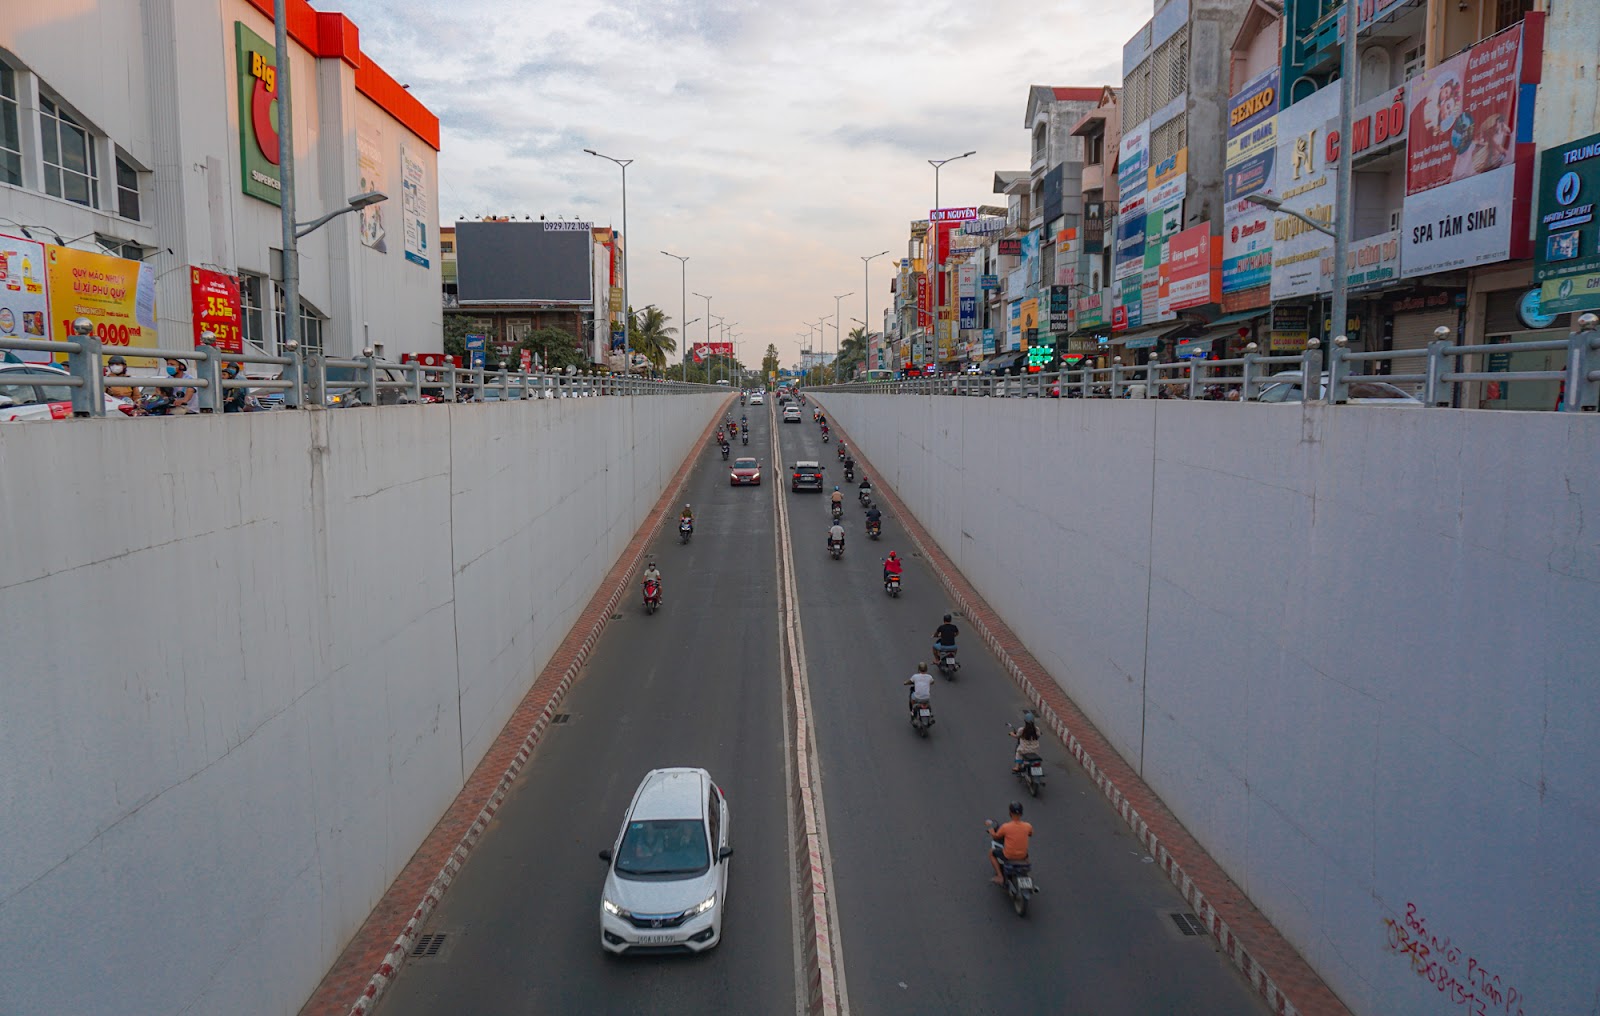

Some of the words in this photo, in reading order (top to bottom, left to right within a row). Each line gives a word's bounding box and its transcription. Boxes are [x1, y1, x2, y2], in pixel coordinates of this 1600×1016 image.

[251, 51, 275, 93] Big
[1229, 86, 1275, 128] SENKO
[1325, 115, 1371, 163] CM
[1563, 142, 1600, 164] TRUNG
[251, 169, 281, 191] SUPERCE
[931, 211, 945, 220] KM
[1564, 204, 1594, 218] SPORT
[544, 221, 590, 231] 0929.172.106
[1413, 223, 1433, 245] SPA
[1439, 214, 1463, 239] TÂM
[1467, 206, 1497, 232] SINH
